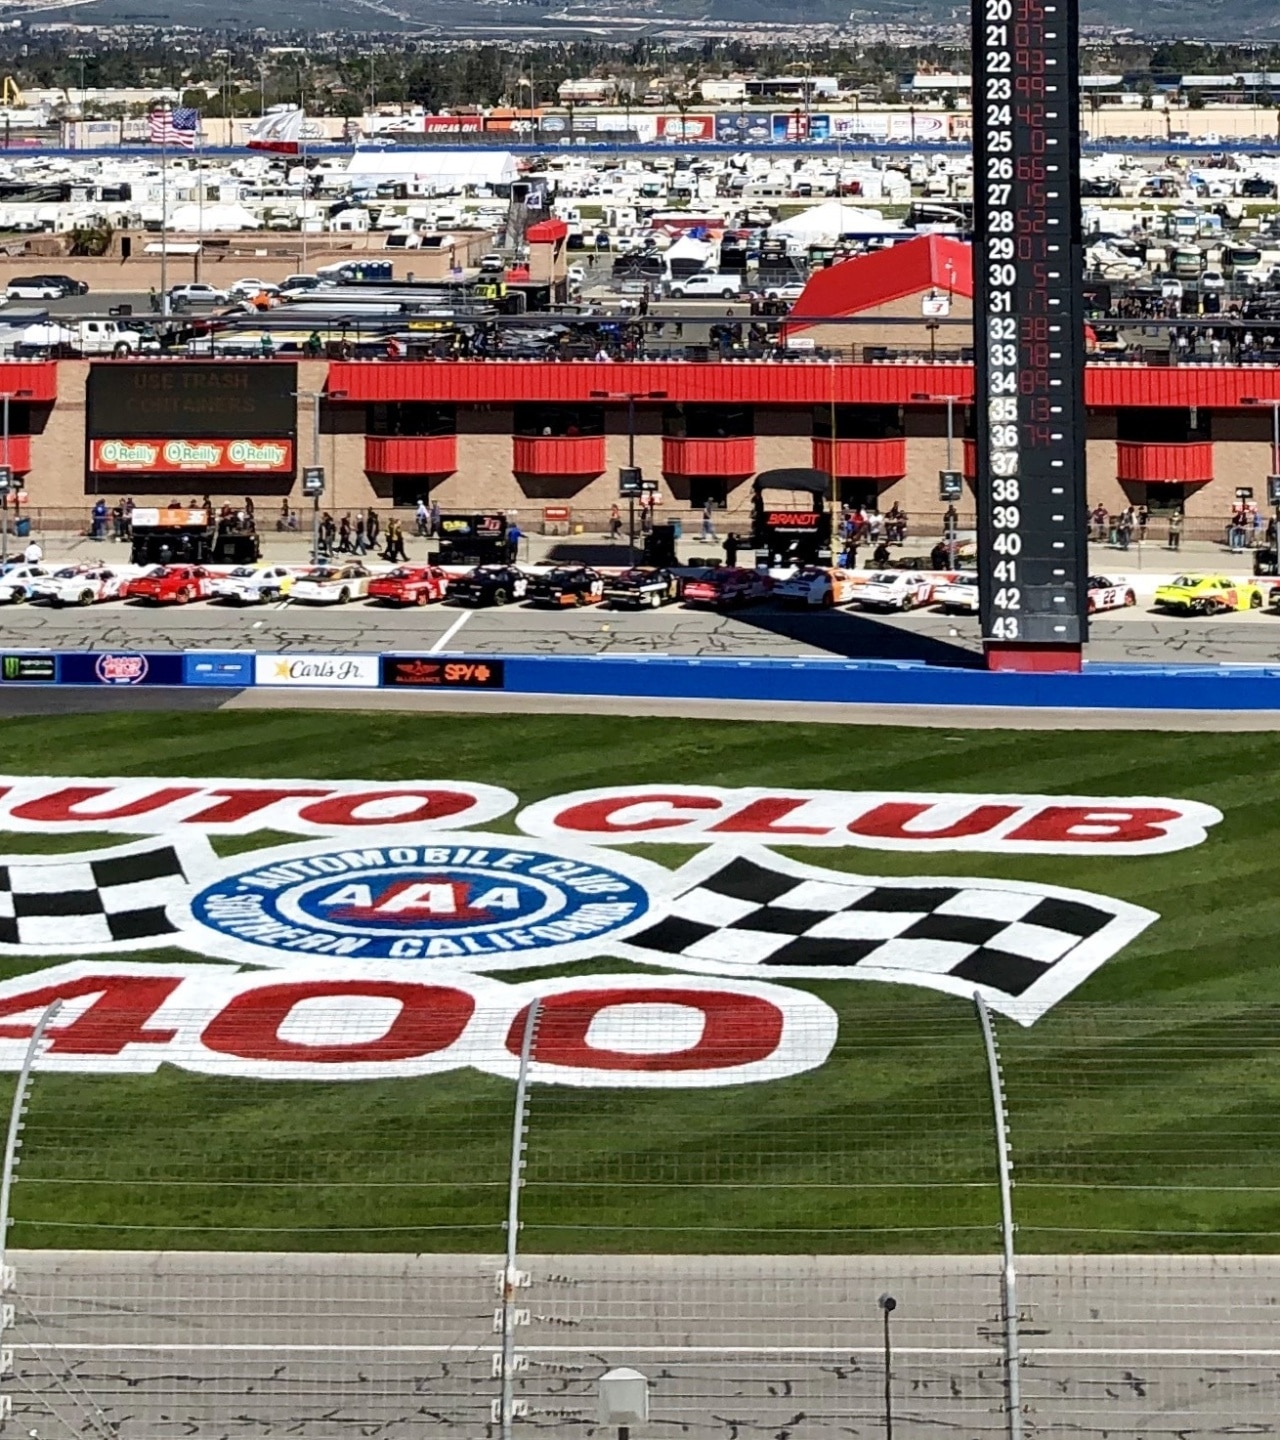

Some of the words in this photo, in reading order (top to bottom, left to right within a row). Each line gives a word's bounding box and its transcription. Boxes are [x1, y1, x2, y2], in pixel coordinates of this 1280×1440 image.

[985, 0, 1013, 20] 20
[986, 25, 1008, 45] 21
[986, 52, 1013, 72] 22
[986, 78, 1013, 99] 23
[986, 105, 1013, 125] 24
[428, 123, 459, 132] LUCAS
[987, 131, 1014, 151] 25
[987, 158, 1014, 179] 26
[987, 184, 1013, 204] 27
[988, 211, 1015, 232] 28
[988, 238, 1015, 259] 29
[989, 264, 1016, 285] 30
[989, 291, 1012, 312] 31
[990, 318, 1016, 339] 32
[990, 345, 1016, 365] 33
[990, 372, 1017, 393] 34
[992, 399, 1018, 421] 35
[992, 426, 1018, 447] 36
[992, 453, 1018, 475] 37
[992, 479, 1017, 501] 38
[767, 513, 819, 525] BRANDT
[992, 506, 1018, 528] 39
[993, 533, 1018, 555] 40
[993, 561, 1017, 582] 41
[993, 588, 1018, 609] 42
[1103, 589, 1116, 604] 22
[991, 617, 1018, 640] 43
[444, 664, 475, 680] SPY
[553, 793, 1184, 842] CLUB
[250, 846, 536, 890] AUTOMOBILE
[527, 857, 628, 894] CLUB
[319, 883, 521, 913] AAA
[204, 893, 372, 956] SOUTHERN
[389, 899, 638, 958] CALIFORNIA
